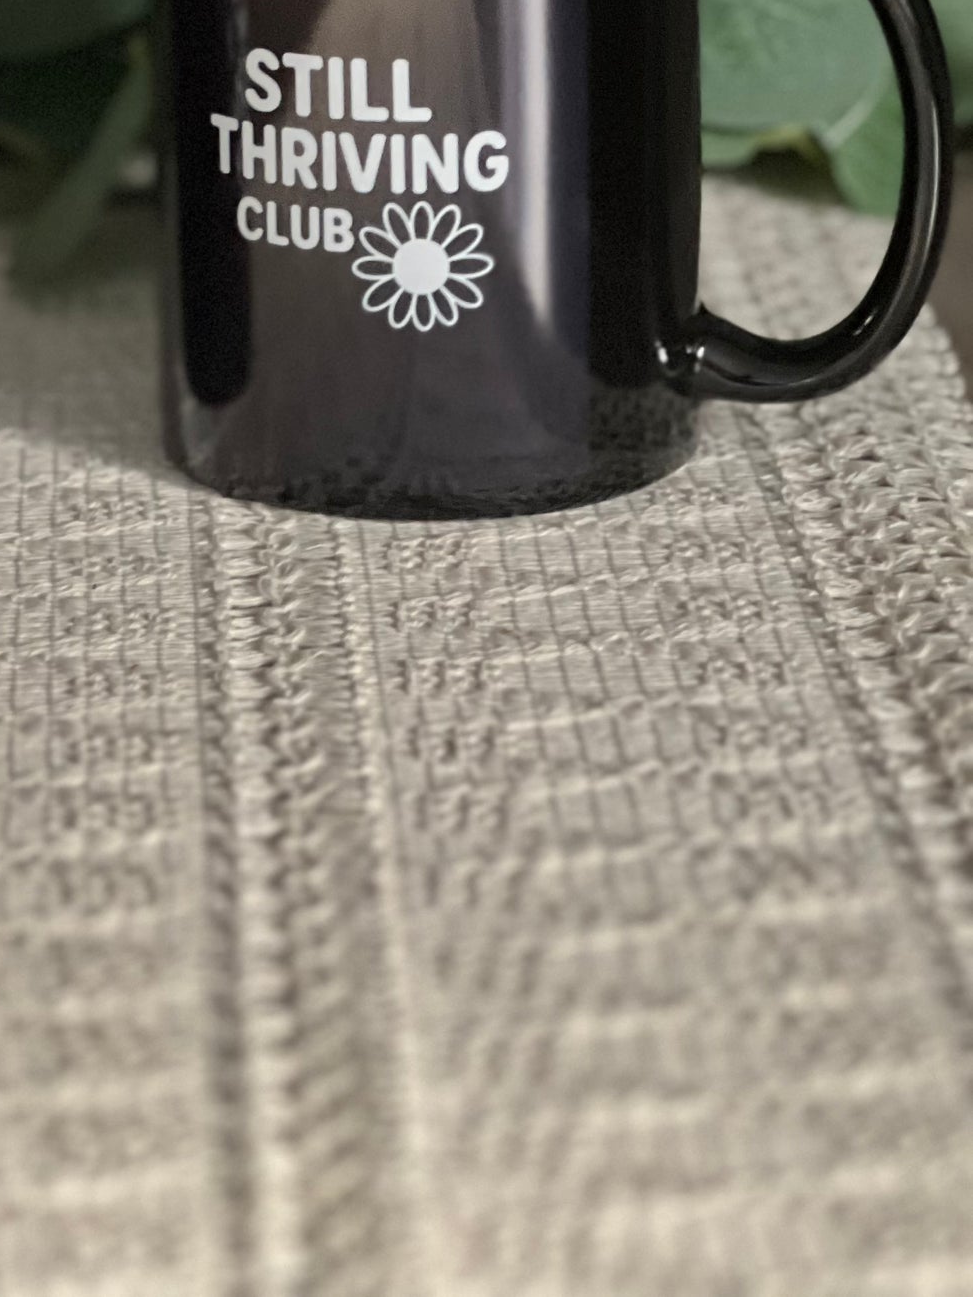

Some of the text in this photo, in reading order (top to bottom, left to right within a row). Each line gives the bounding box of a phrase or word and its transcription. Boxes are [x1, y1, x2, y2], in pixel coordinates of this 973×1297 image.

[245, 48, 432, 122] STILL
[210, 113, 509, 194] THRIVING
[237, 196, 355, 252] CLUB
